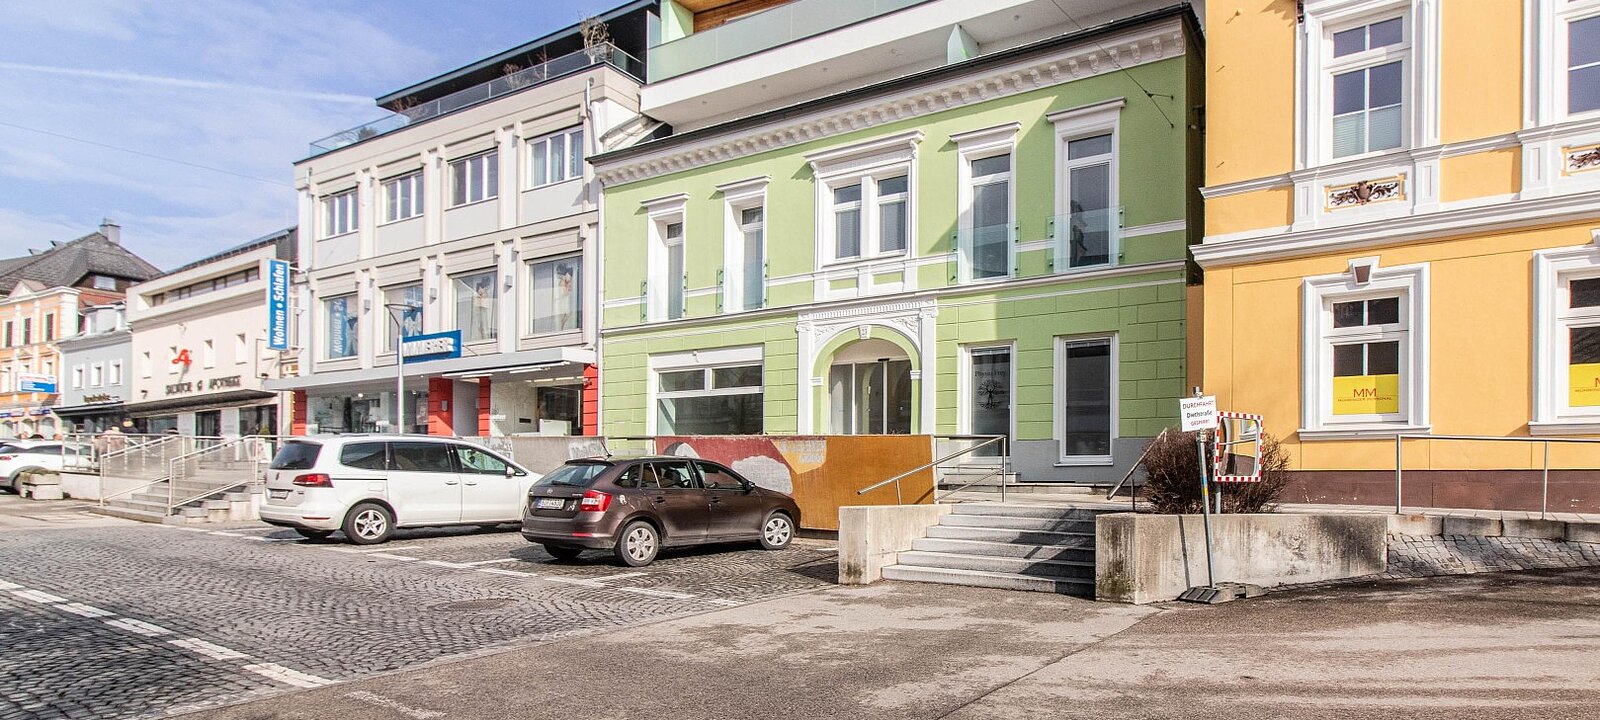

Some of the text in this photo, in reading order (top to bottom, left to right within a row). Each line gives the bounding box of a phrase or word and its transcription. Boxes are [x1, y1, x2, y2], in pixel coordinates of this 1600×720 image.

[272, 263, 285, 345] Wohnen Schlafen
[1353, 388, 1377, 398] MM
[1182, 399, 1214, 410] DURCHFAHRT
